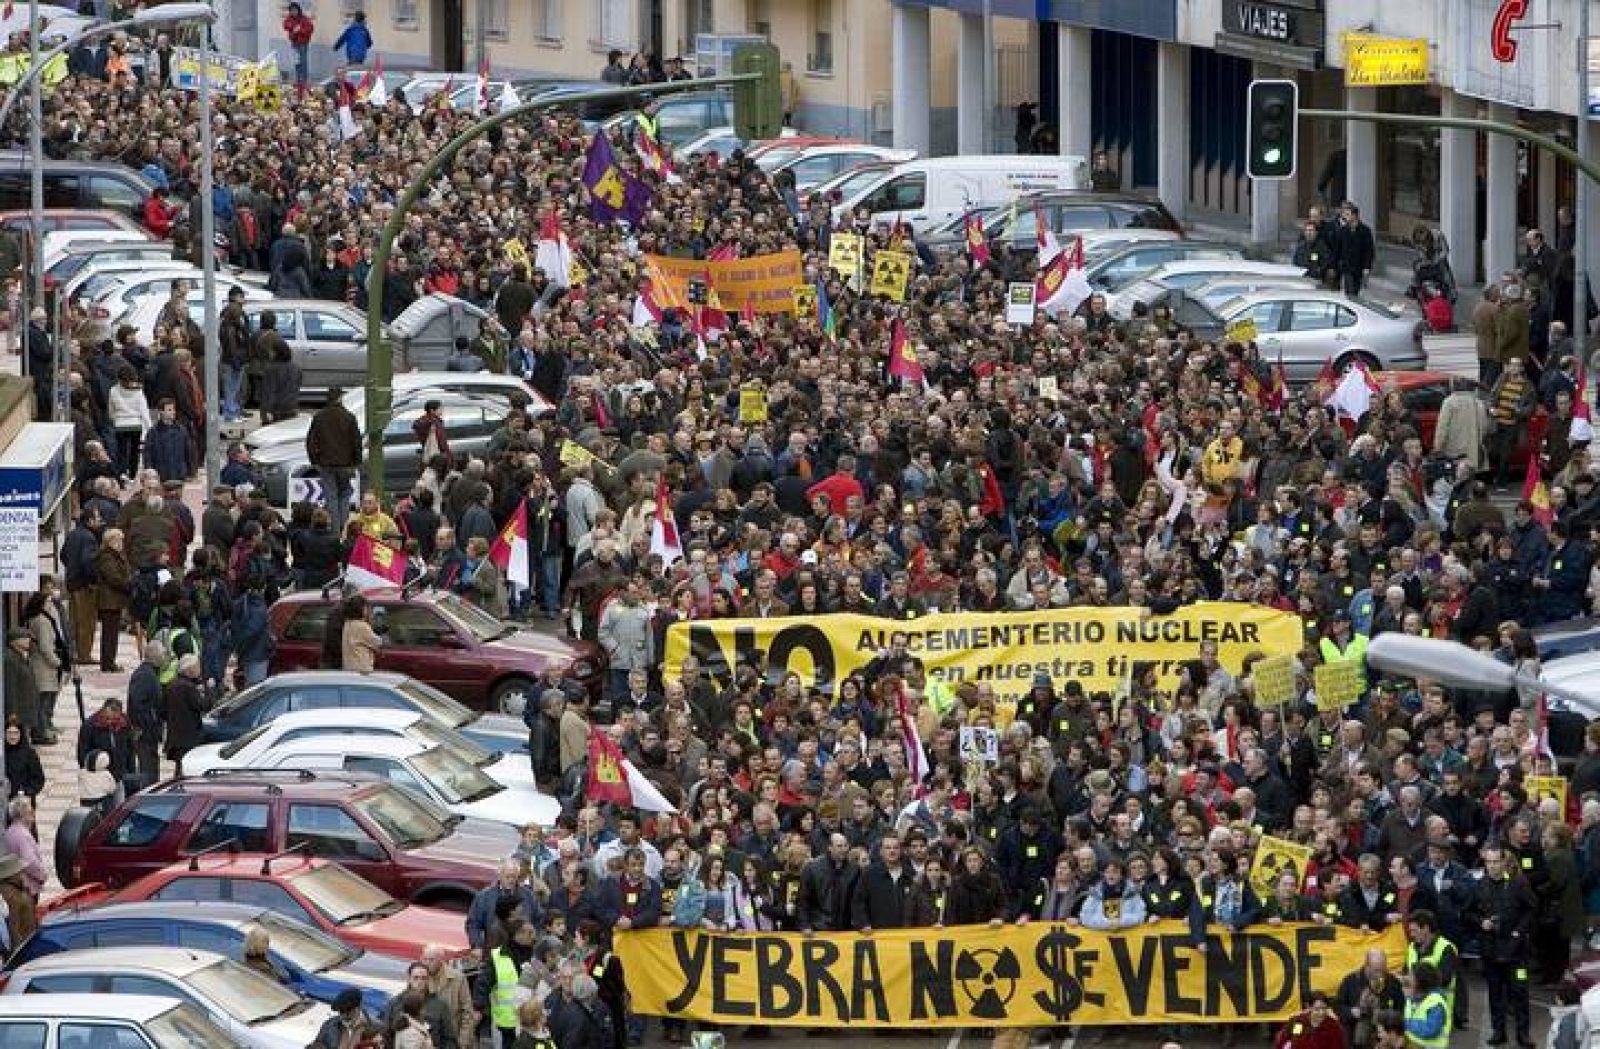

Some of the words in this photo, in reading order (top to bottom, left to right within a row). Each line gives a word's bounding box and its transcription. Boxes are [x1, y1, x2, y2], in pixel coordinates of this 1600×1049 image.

[1237, 4, 1287, 38] VIAJES
[907, 620, 1104, 650] CEMENTERIO
[1117, 619, 1260, 643] NUCLEAR
[977, 657, 1095, 680] nuestra
[666, 931, 890, 1024] YEBRA
[1108, 926, 1336, 1017] VENDE
